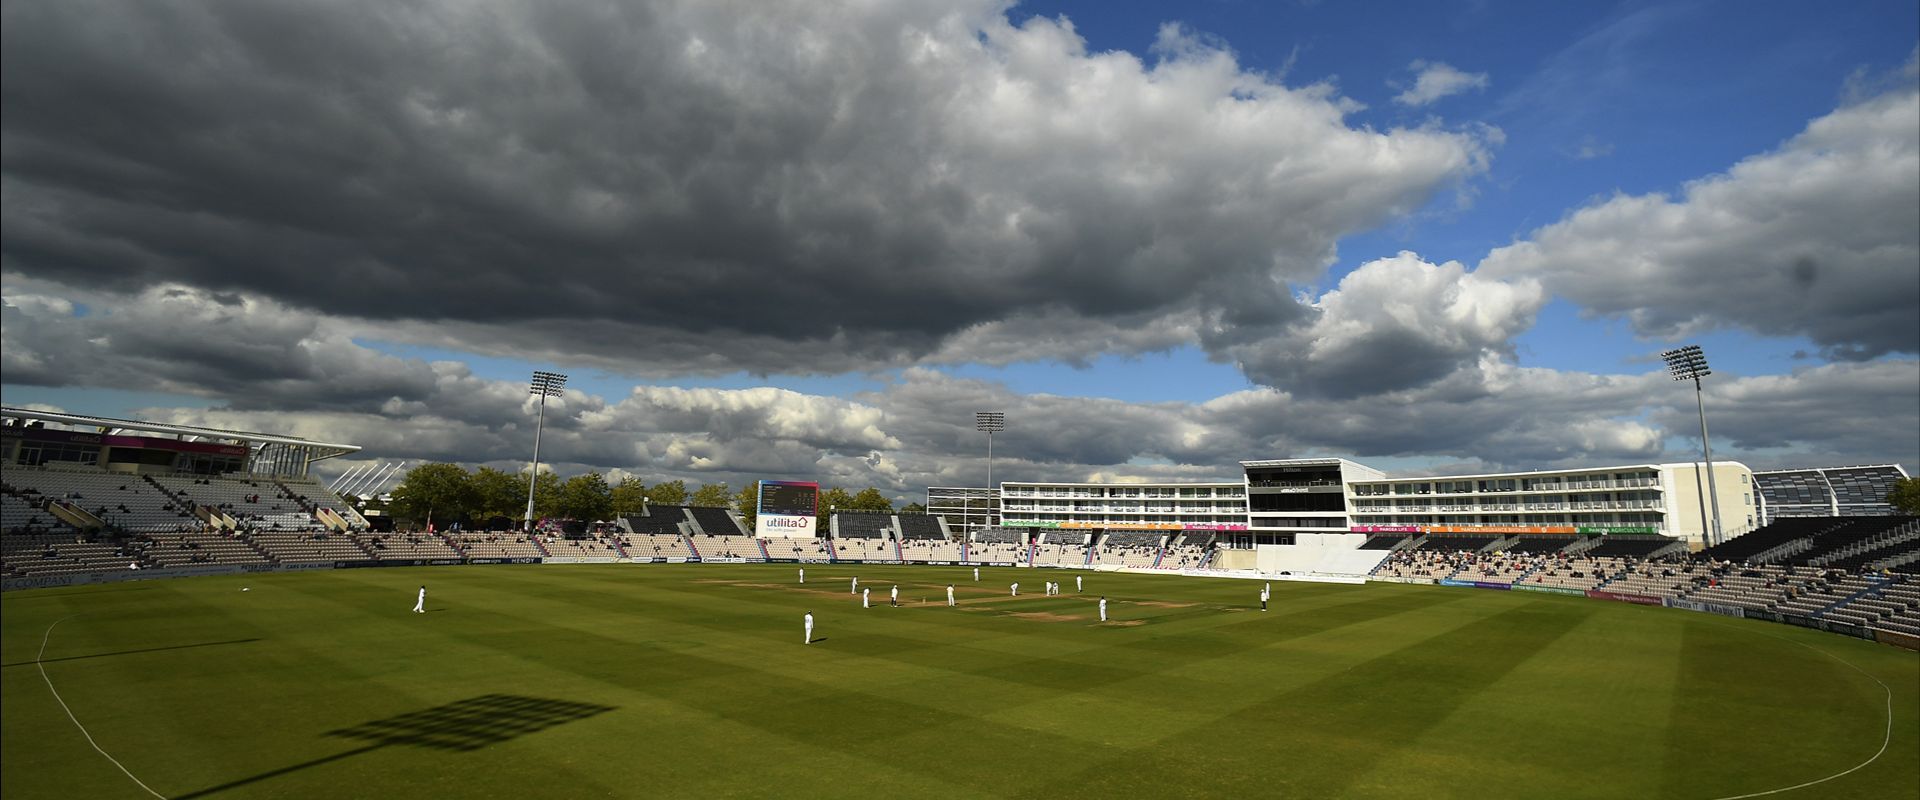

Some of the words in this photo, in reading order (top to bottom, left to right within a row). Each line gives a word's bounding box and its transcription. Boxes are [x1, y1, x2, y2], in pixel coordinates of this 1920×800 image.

[766, 517, 798, 528] utilita
[15, 576, 74, 588] COMPANY
[1673, 599, 1691, 608] Matrix
[1711, 604, 1734, 614] Matrix
